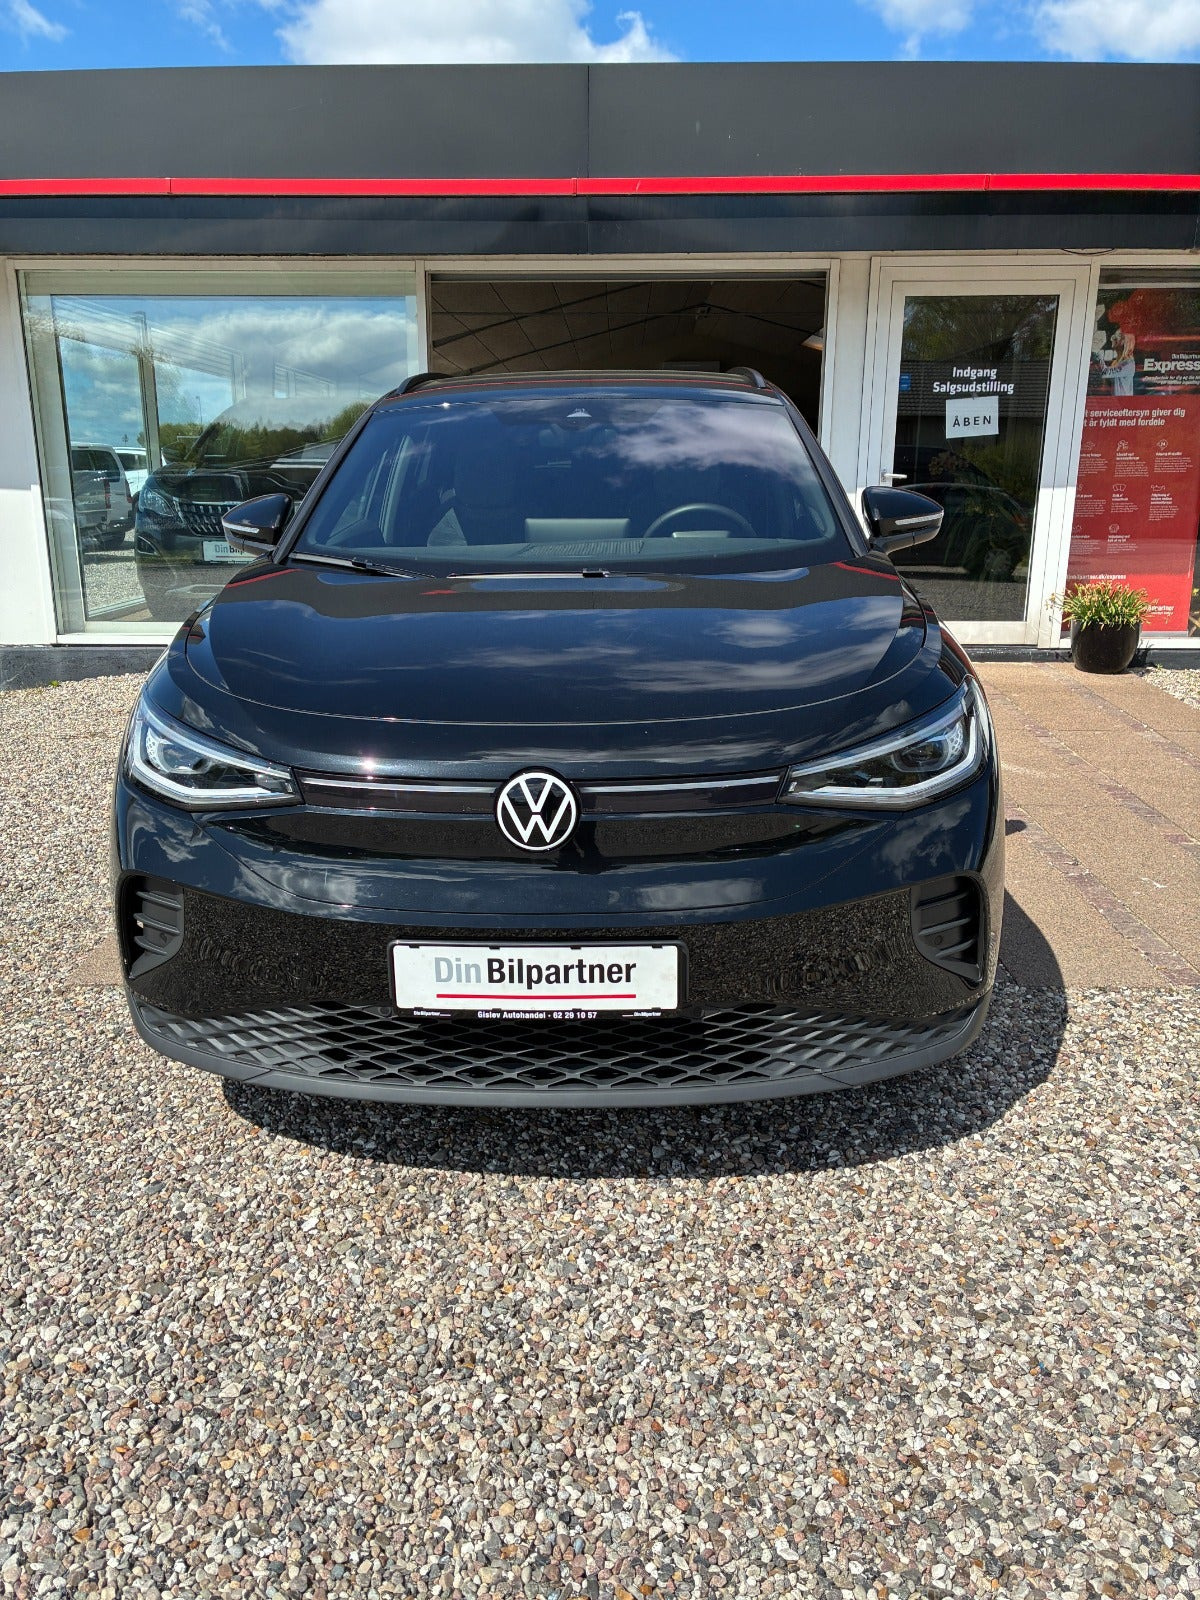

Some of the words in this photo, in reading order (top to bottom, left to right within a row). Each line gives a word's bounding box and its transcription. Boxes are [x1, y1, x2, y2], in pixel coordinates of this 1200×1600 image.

[1144, 358, 1200, 374] Express
[952, 366, 998, 380] Indgang
[932, 380, 1015, 395] Salgsudstilling
[1090, 408, 1150, 418] serviceeftersyn
[1151, 408, 1172, 418] giver
[1173, 408, 1186, 419] dig
[952, 415, 992, 428] ÅBEN
[1089, 418, 1097, 427] år
[1099, 418, 1118, 429] fyldt
[1119, 418, 1136, 427] med
[1137, 417, 1166, 427] fordele
[477, 1010, 501, 1019] Gislev
[502, 1010, 546, 1019] Autohandel
[553, 1011, 564, 1019] 62
[564, 1011, 575, 1019] 29
[576, 1011, 587, 1019] 10
[587, 1011, 598, 1019] 57
